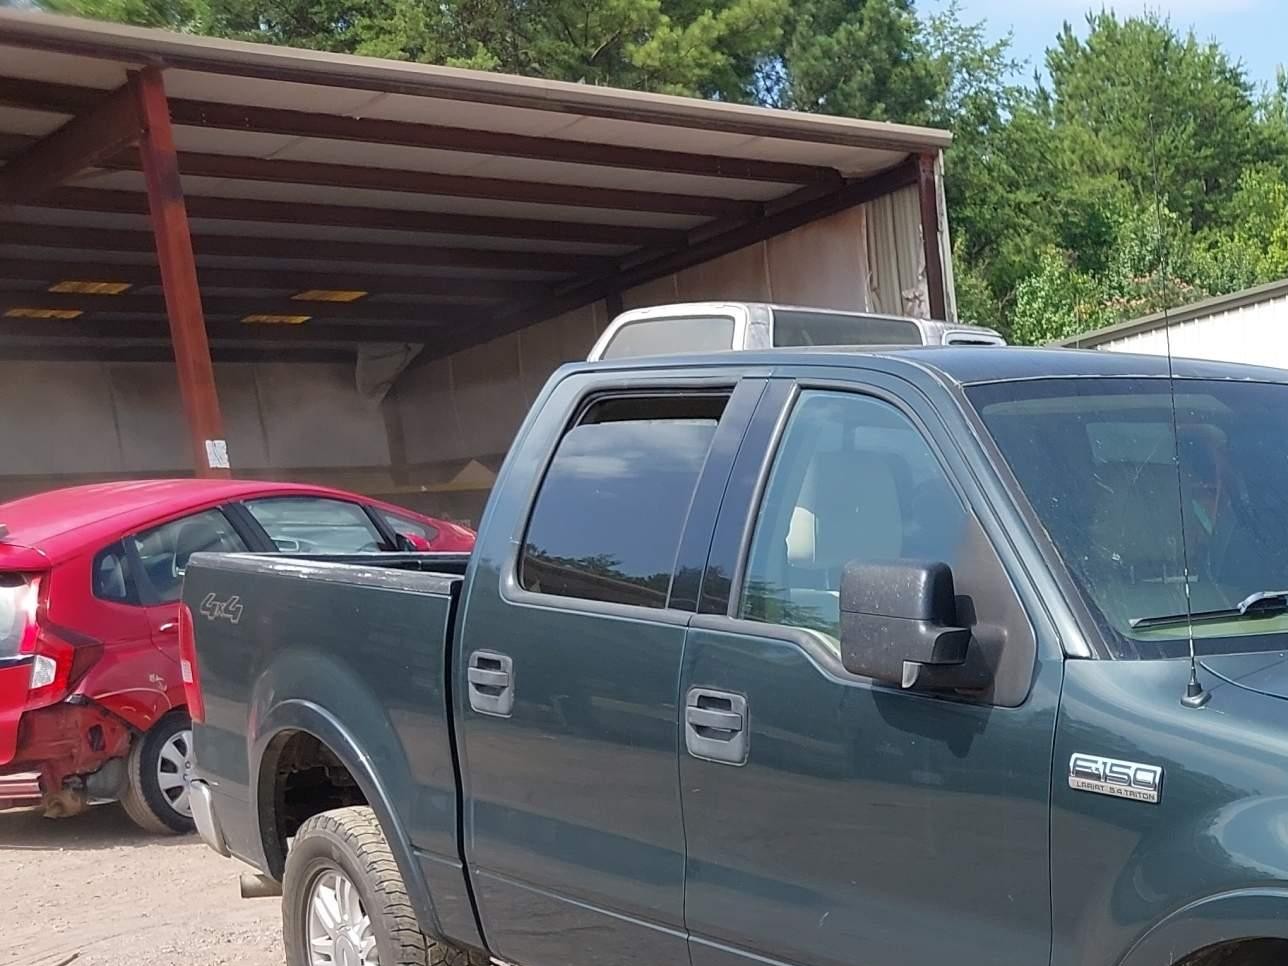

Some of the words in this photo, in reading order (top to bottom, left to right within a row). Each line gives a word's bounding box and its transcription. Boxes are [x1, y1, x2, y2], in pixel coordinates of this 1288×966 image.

[200, 593, 243, 624] 4x4
[1076, 781, 1106, 793] LARIAT
[1124, 789, 1156, 801] TRITON
